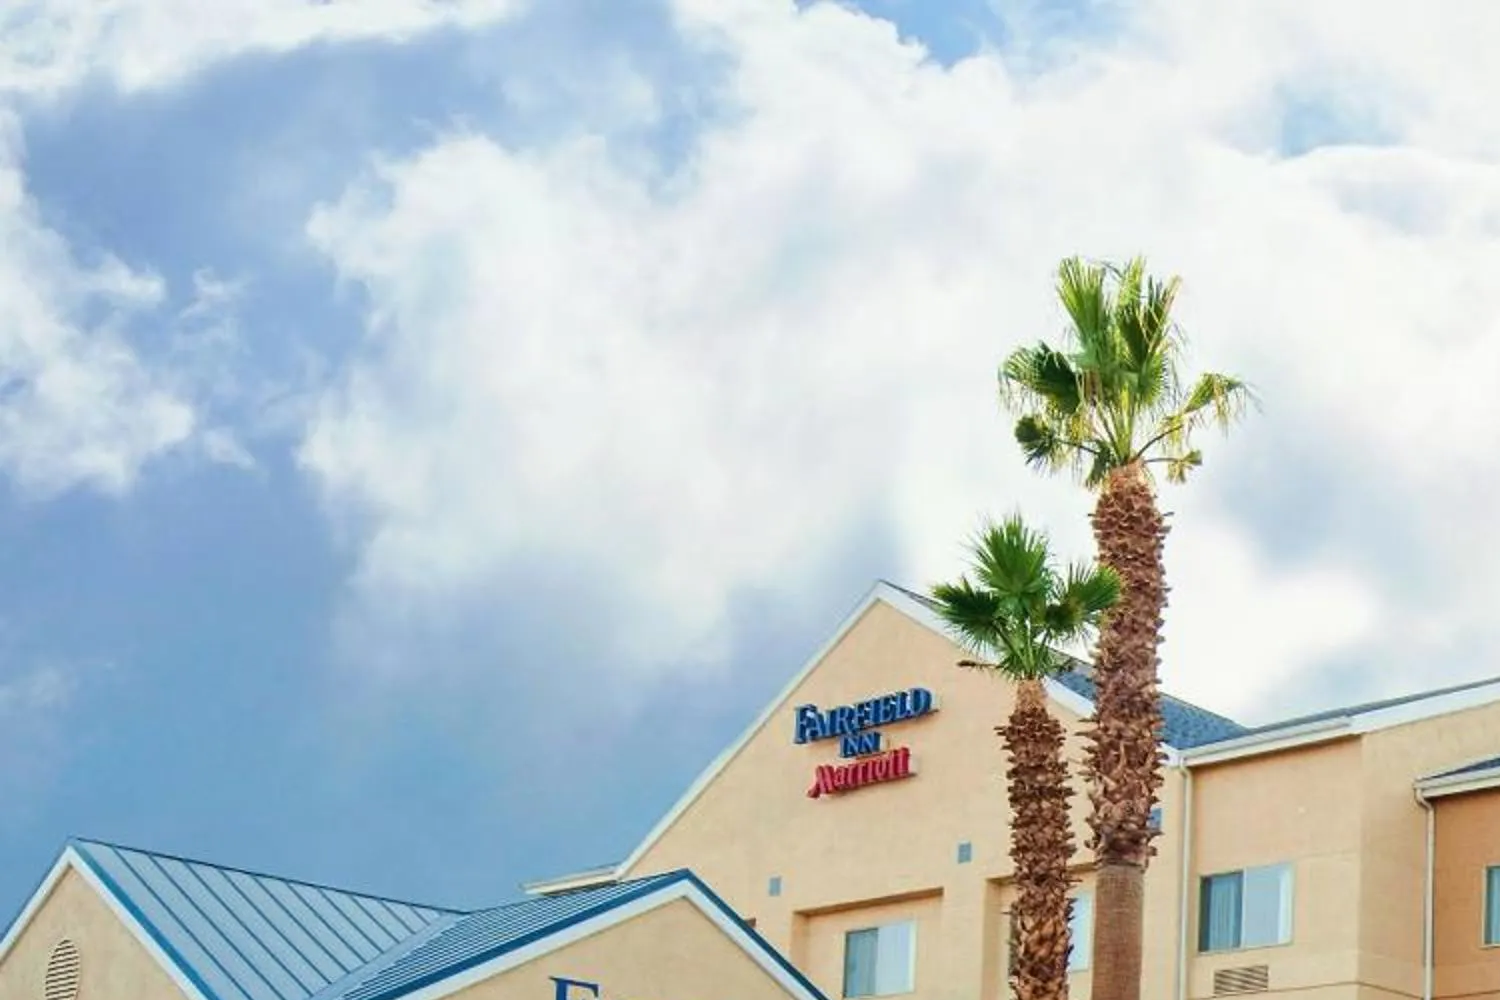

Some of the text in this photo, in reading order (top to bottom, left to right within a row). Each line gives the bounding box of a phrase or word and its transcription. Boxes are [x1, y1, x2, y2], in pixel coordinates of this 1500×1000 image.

[794, 687, 933, 745] FAIRFIELD
[839, 731, 882, 759] INN
[806, 746, 911, 799] Marriott
